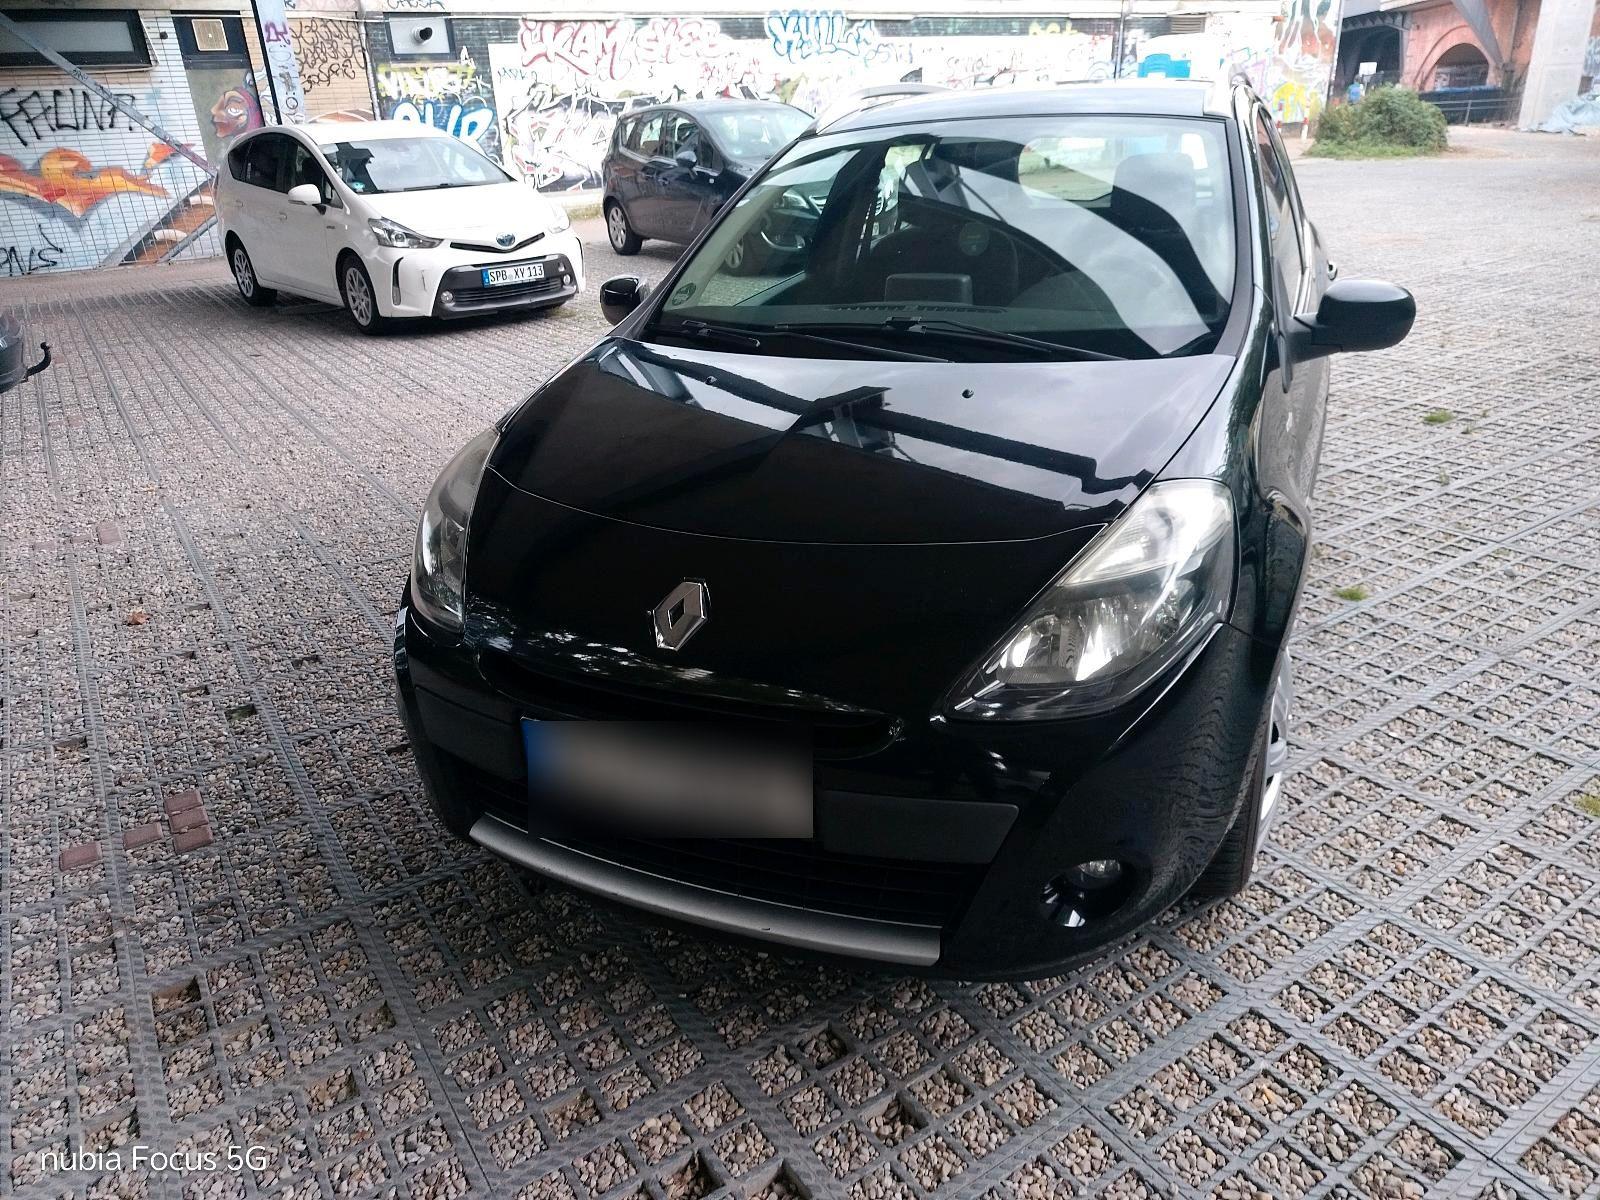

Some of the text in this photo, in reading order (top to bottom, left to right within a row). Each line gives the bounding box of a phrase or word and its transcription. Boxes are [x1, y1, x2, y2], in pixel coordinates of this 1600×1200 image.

[489, 269, 508, 283] SPB
[513, 267, 525, 280] XY
[527, 265, 543, 278] 113
